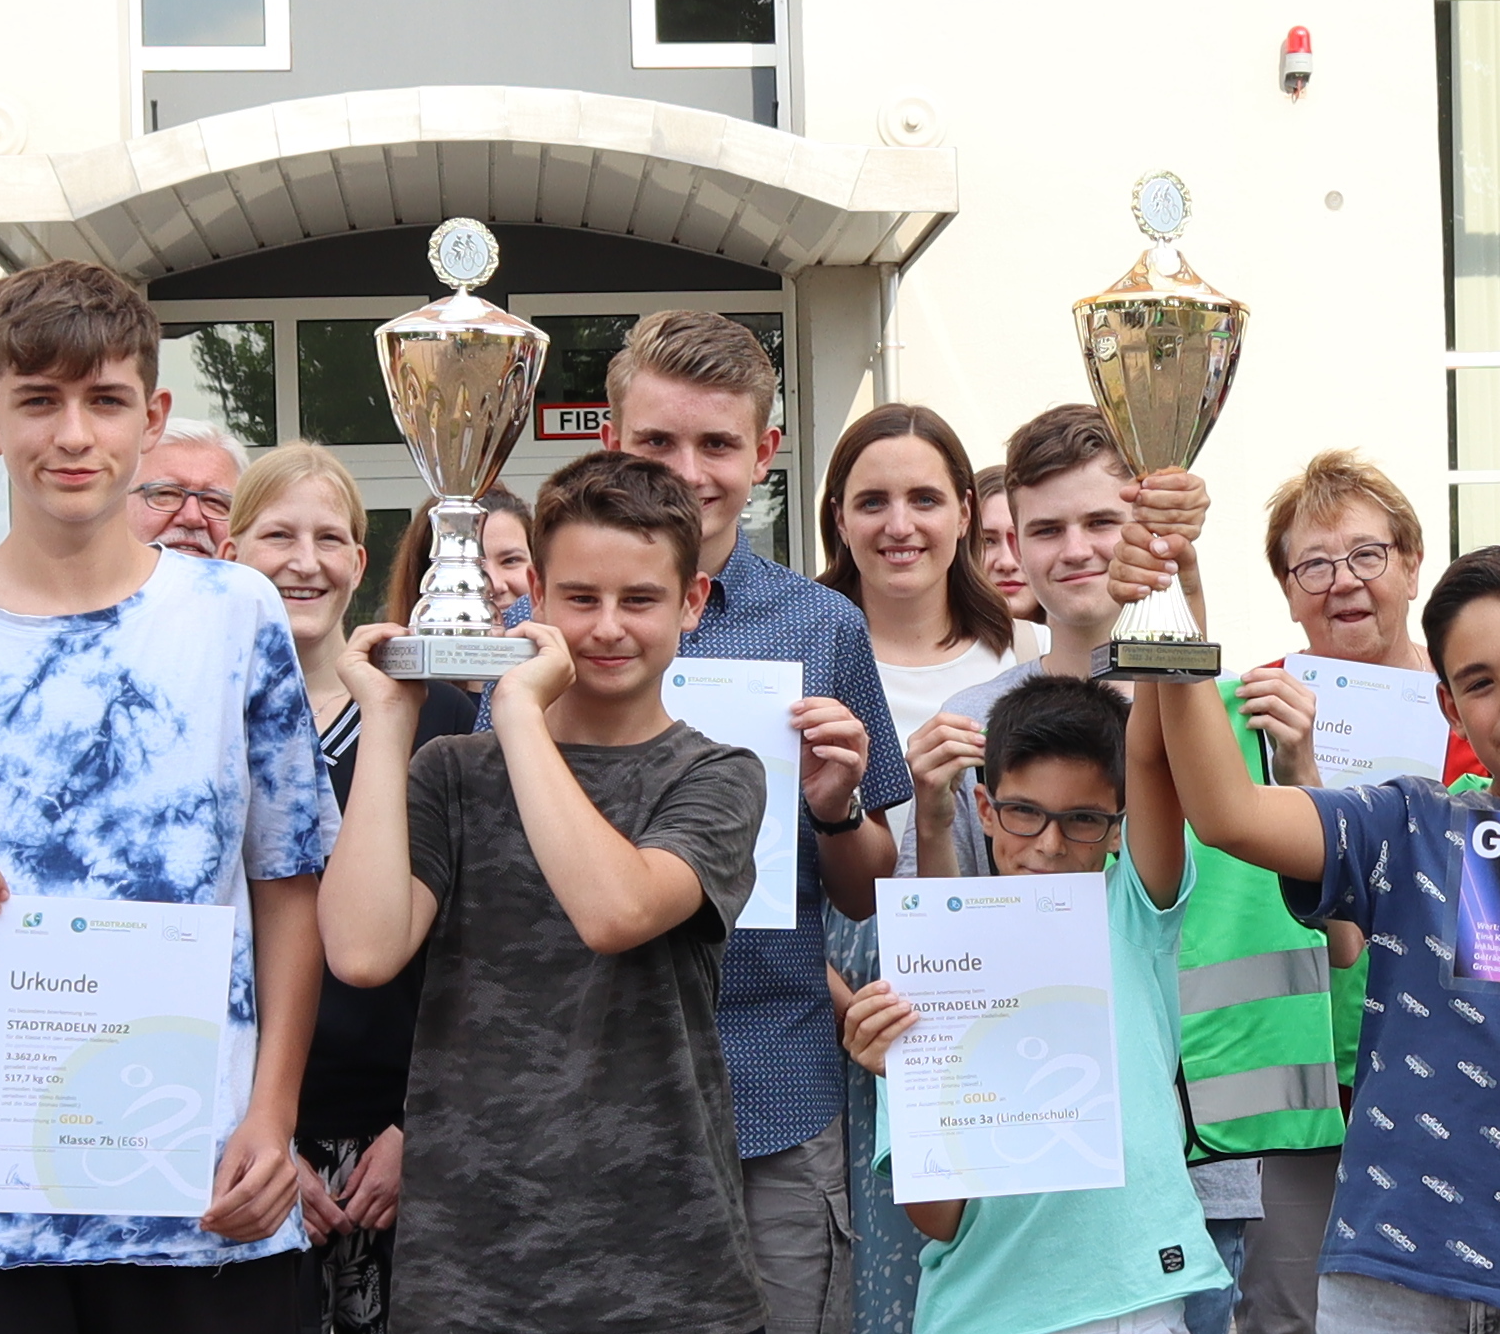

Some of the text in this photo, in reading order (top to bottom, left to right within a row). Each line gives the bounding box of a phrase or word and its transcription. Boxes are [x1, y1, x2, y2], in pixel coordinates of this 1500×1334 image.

[1314, 719, 1352, 735] unde
[1314, 752, 1373, 769] RADELN 2022
[896, 952, 982, 974] Urkunde
[10, 970, 98, 993] Urkunde
[909, 998, 1019, 1013] TADTRADELN 2022
[1454, 998, 1485, 1024] adidas
[6, 1020, 130, 1034] STADTRADELN 2022
[902, 1033, 953, 1044] 2.627,6 km
[6, 1052, 57, 1062] 3.362,0 km
[905, 1057, 929, 1066] 404,7
[932, 1056, 942, 1065] kg
[4, 1074, 30, 1084] 517,7
[33, 1075, 43, 1084] kg
[1457, 1061, 1488, 1088] adidas
[963, 1092, 996, 1104] GOLD
[59, 1114, 94, 1125] GOLD
[940, 1108, 1079, 1127] Klasse 3a (Lindenschule)
[59, 1135, 148, 1148] Klasse 7b (EGS)
[1421, 1174, 1455, 1204] adidas
[1382, 1223, 1417, 1253] adidas
[1455, 1240, 1494, 1270] adidas
